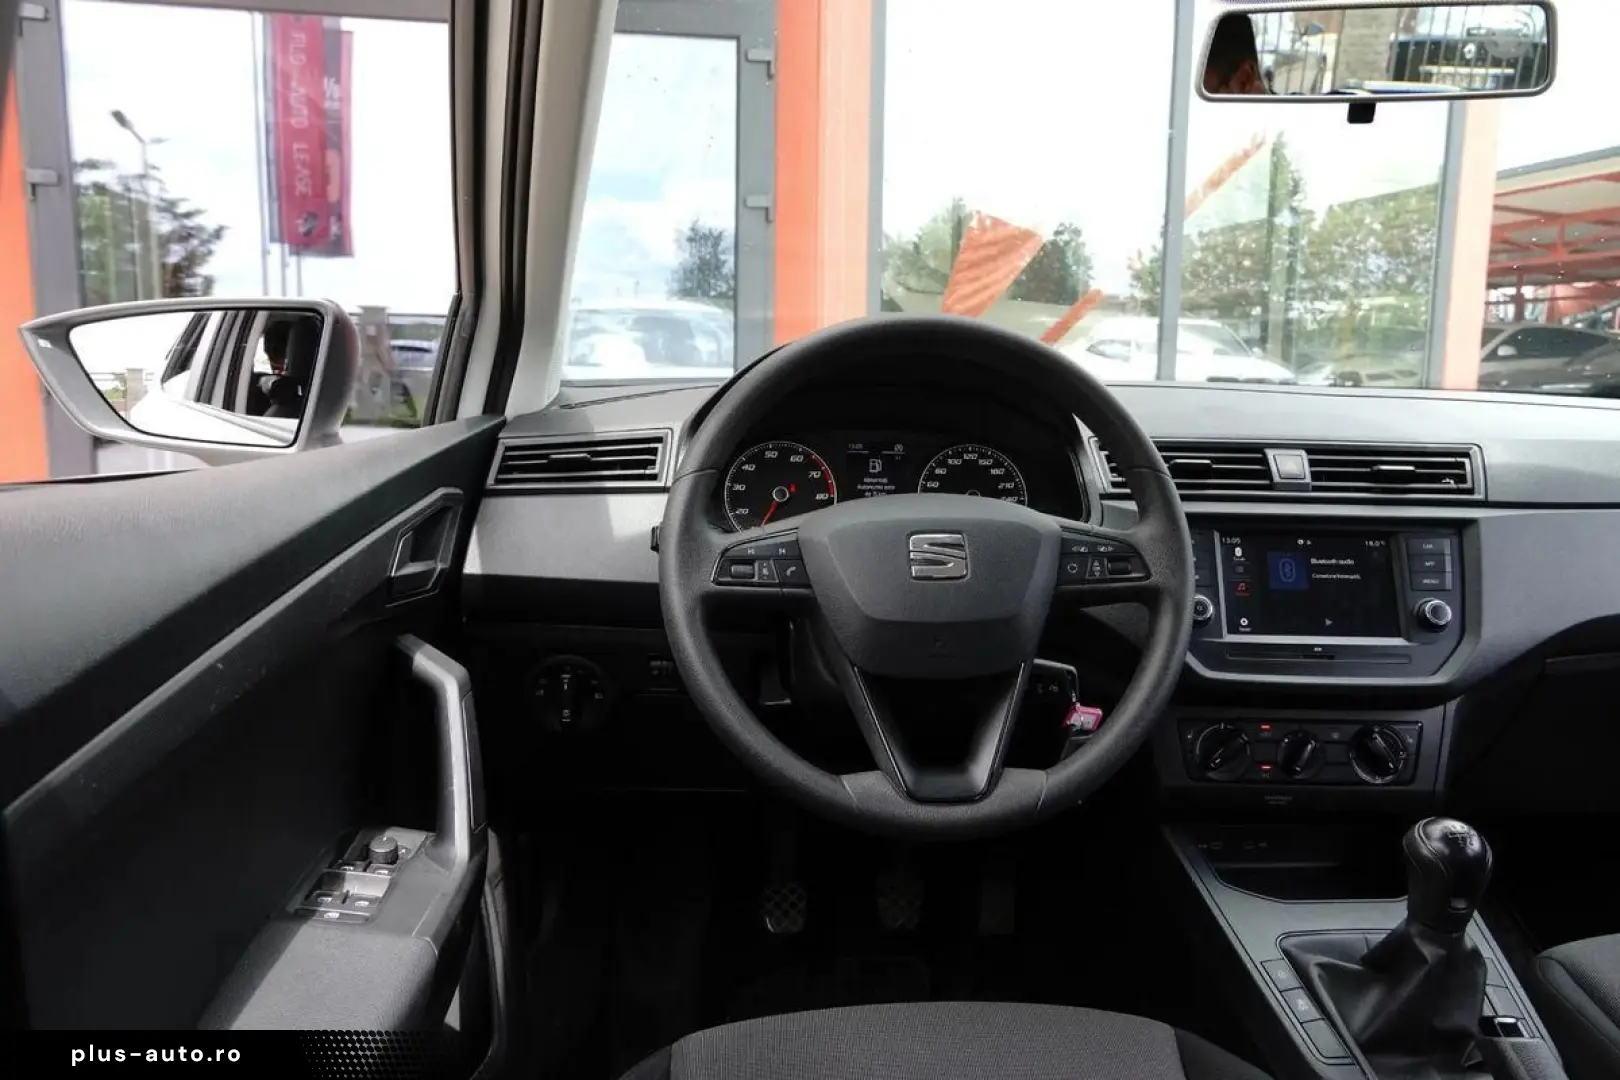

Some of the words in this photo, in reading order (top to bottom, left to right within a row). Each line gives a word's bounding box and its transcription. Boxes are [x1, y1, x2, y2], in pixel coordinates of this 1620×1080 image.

[292, 141, 313, 197] LEASE
[764, 450, 779, 459] 50
[790, 454, 804, 463] 60
[978, 458, 993, 466] 150
[741, 463, 756, 471] 40
[808, 470, 821, 479] 70
[815, 493, 829, 501] 80
